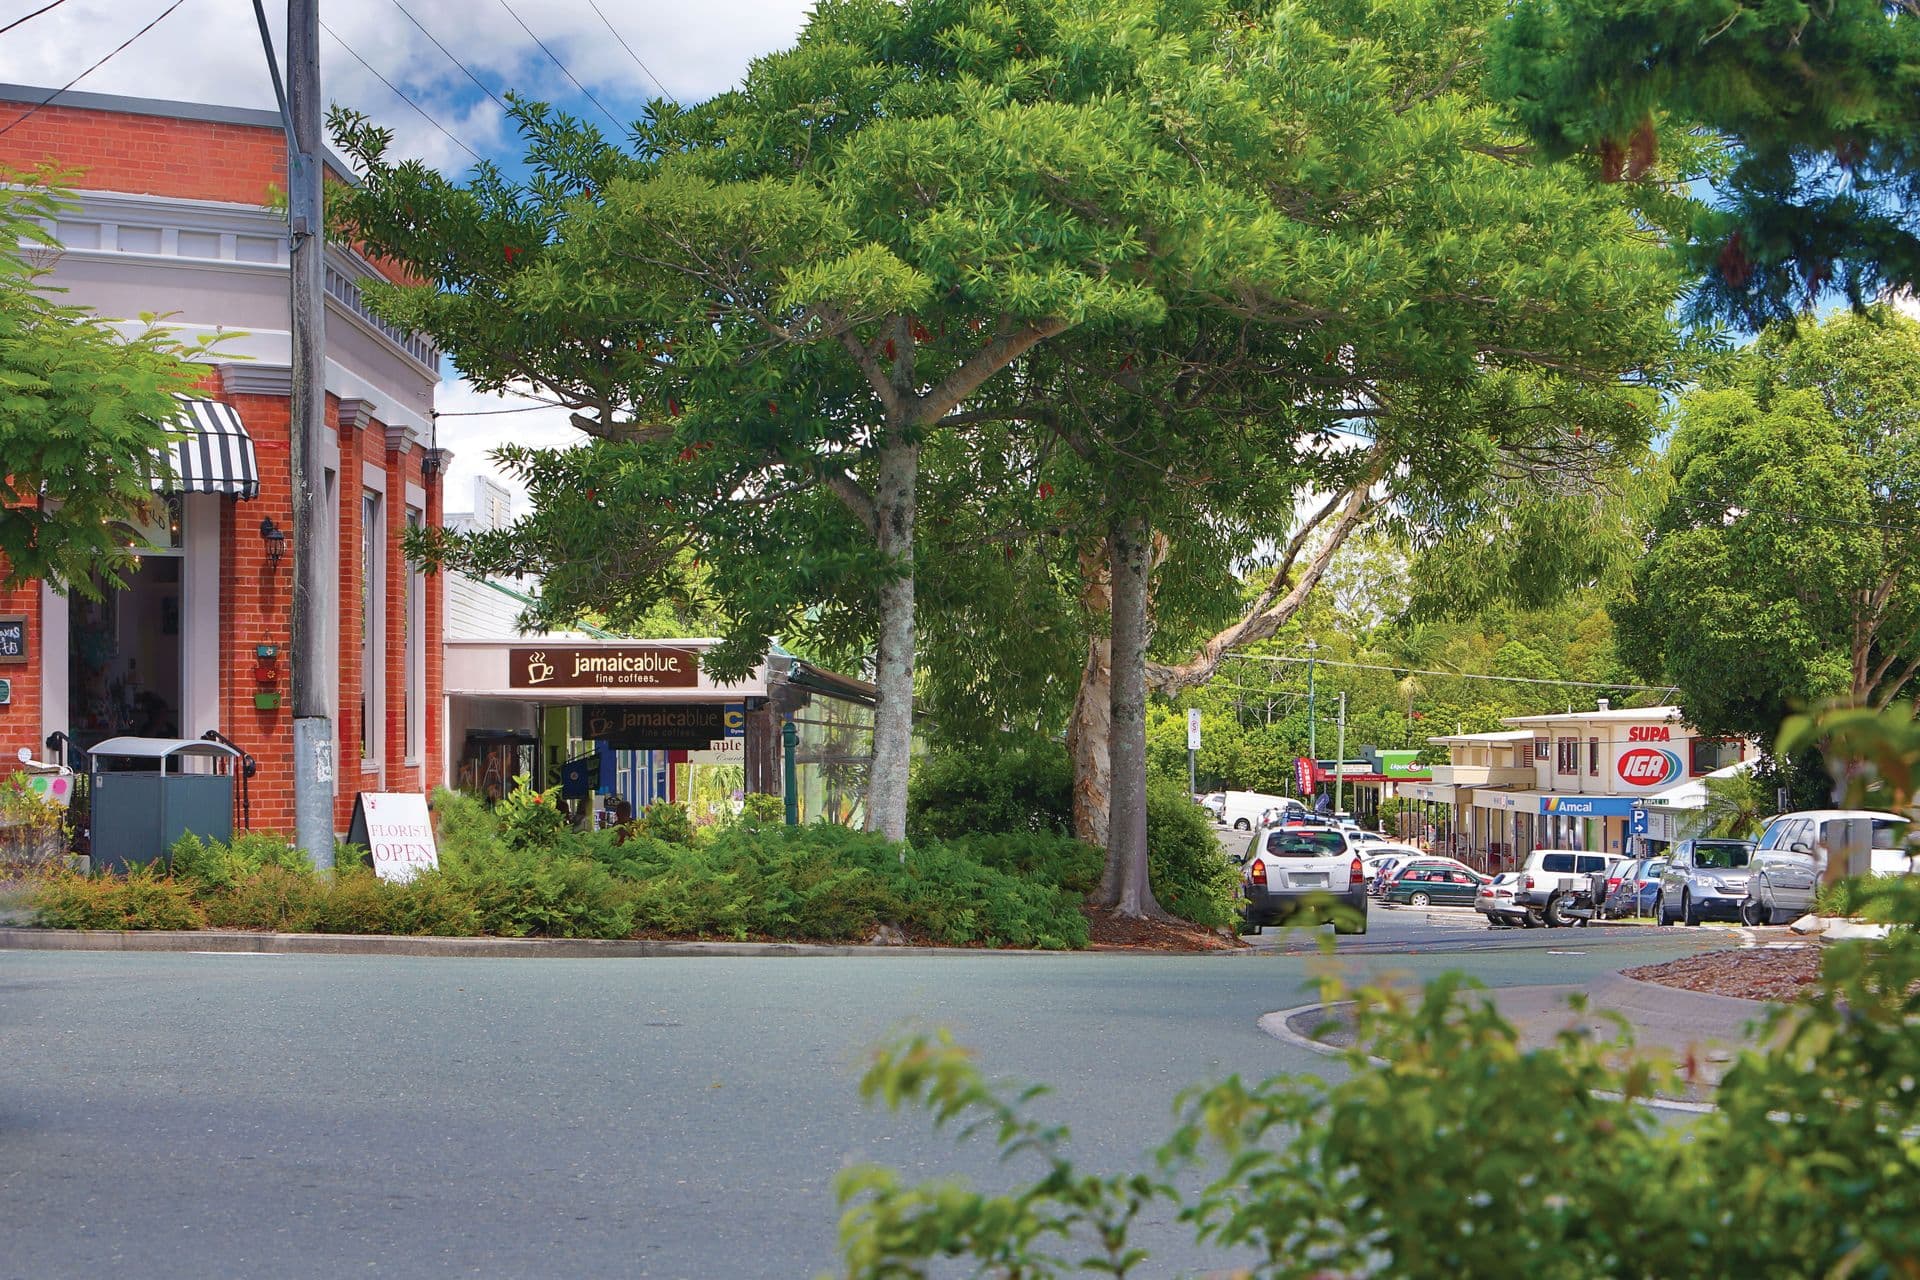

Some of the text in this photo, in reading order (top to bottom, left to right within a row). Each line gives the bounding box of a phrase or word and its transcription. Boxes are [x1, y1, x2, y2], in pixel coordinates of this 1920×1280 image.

[571, 651, 678, 678] jamaicablue
[595, 673, 654, 683] fine coffees
[619, 708, 718, 731] jamaicablue
[1628, 726, 1670, 742] SUPA
[712, 739, 742, 752] aple
[1623, 755, 1664, 777] IGA
[1558, 801, 1593, 812] Amcal
[1634, 811, 1645, 823] P
[371, 824, 429, 837] FLORIST
[375, 843, 433, 862] OPEN
